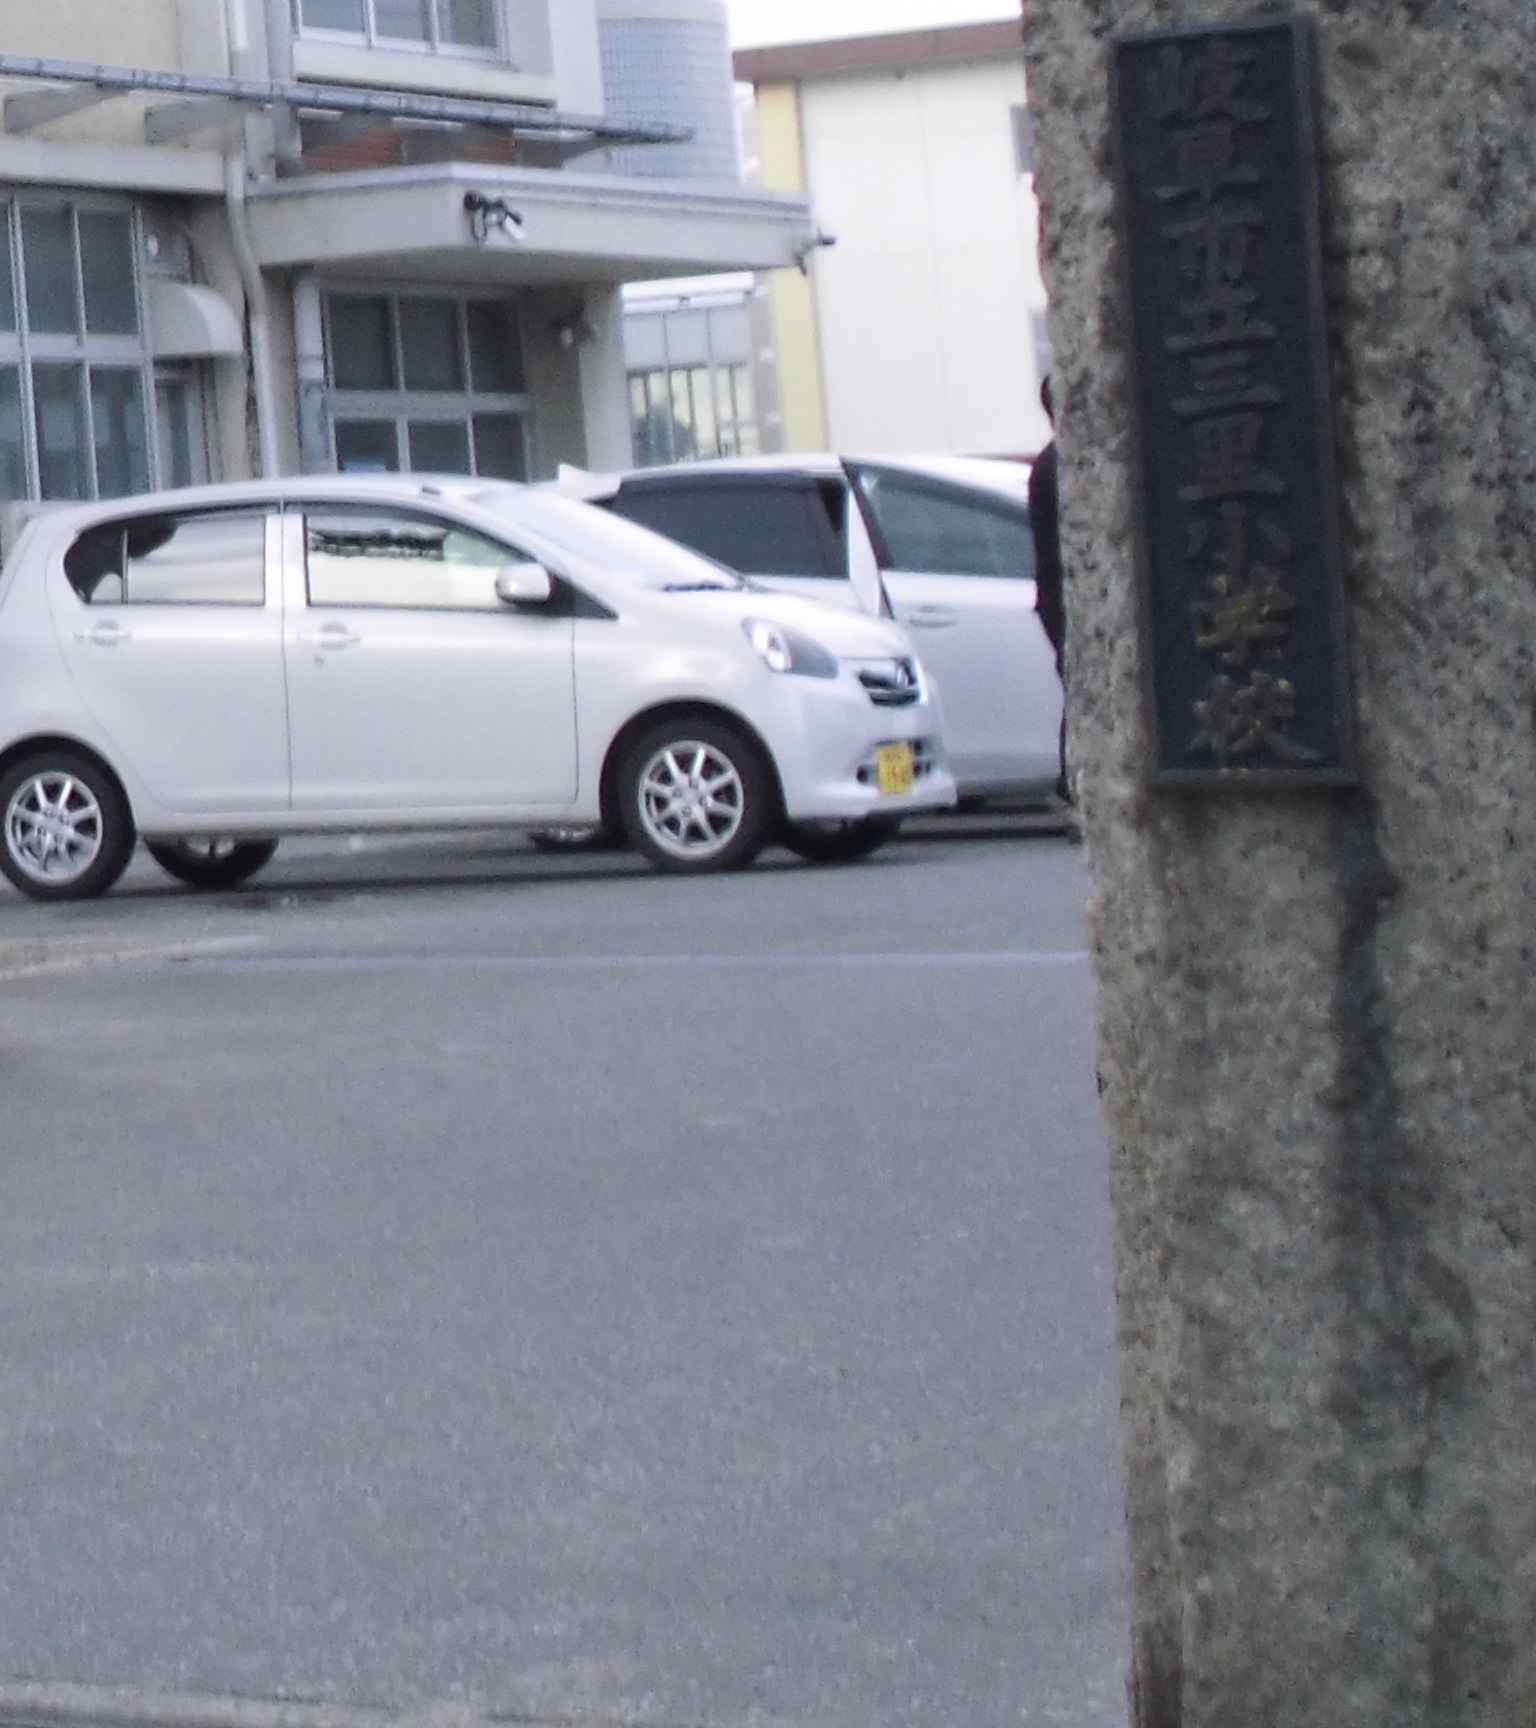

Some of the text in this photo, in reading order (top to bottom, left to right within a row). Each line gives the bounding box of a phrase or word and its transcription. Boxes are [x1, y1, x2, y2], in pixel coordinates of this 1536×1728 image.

[1145, 38, 1320, 763] 岐阜市立三里小学校
